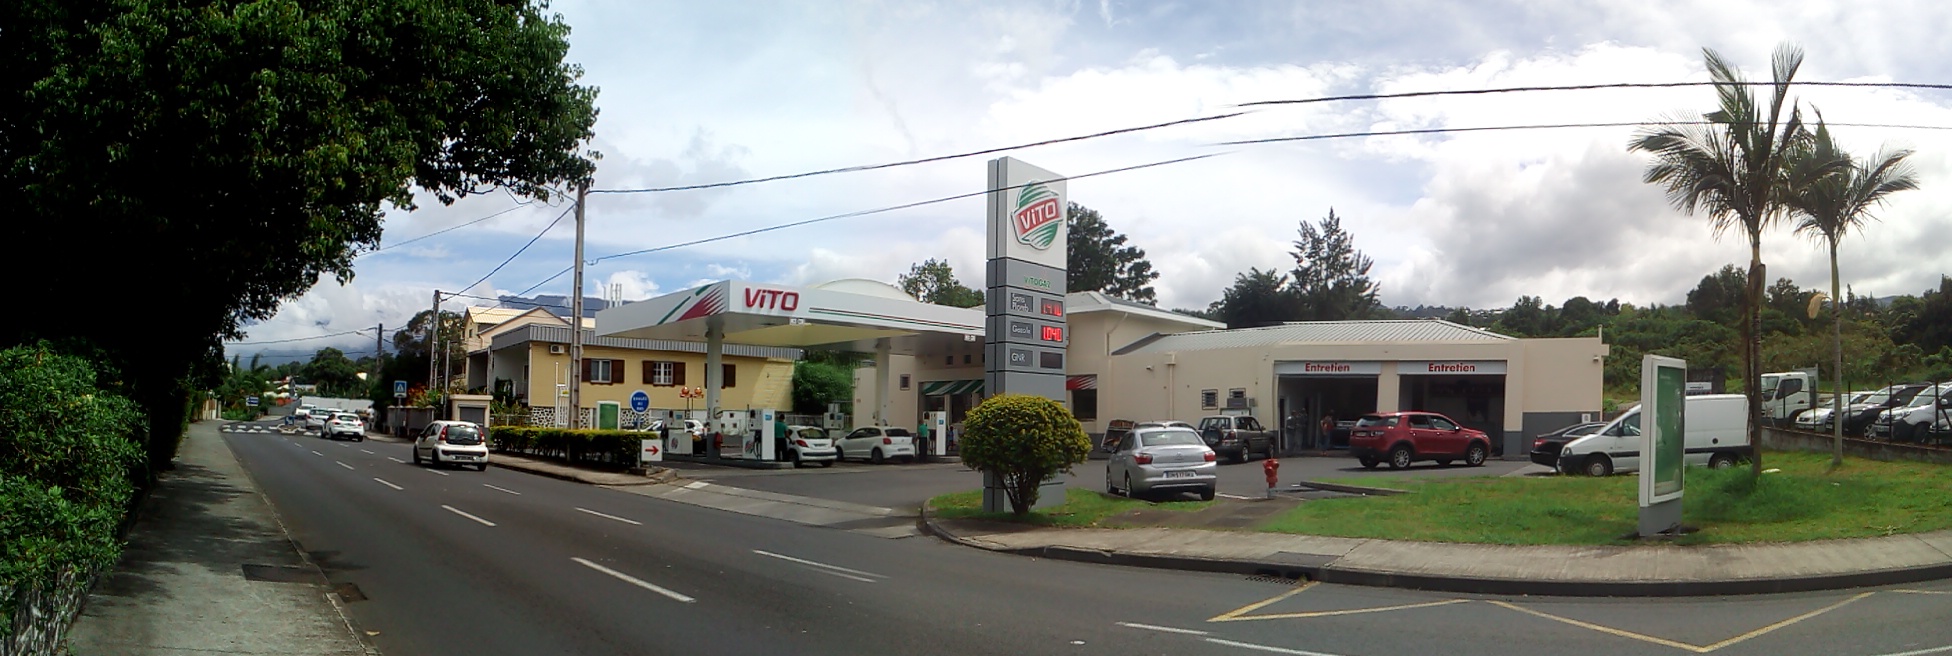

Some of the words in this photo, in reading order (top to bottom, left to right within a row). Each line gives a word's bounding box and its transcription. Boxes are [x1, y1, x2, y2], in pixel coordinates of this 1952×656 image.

[1012, 293, 1025, 303] Sans
[1305, 363, 1350, 372] Entretien
[1428, 363, 1475, 372] Entretien
